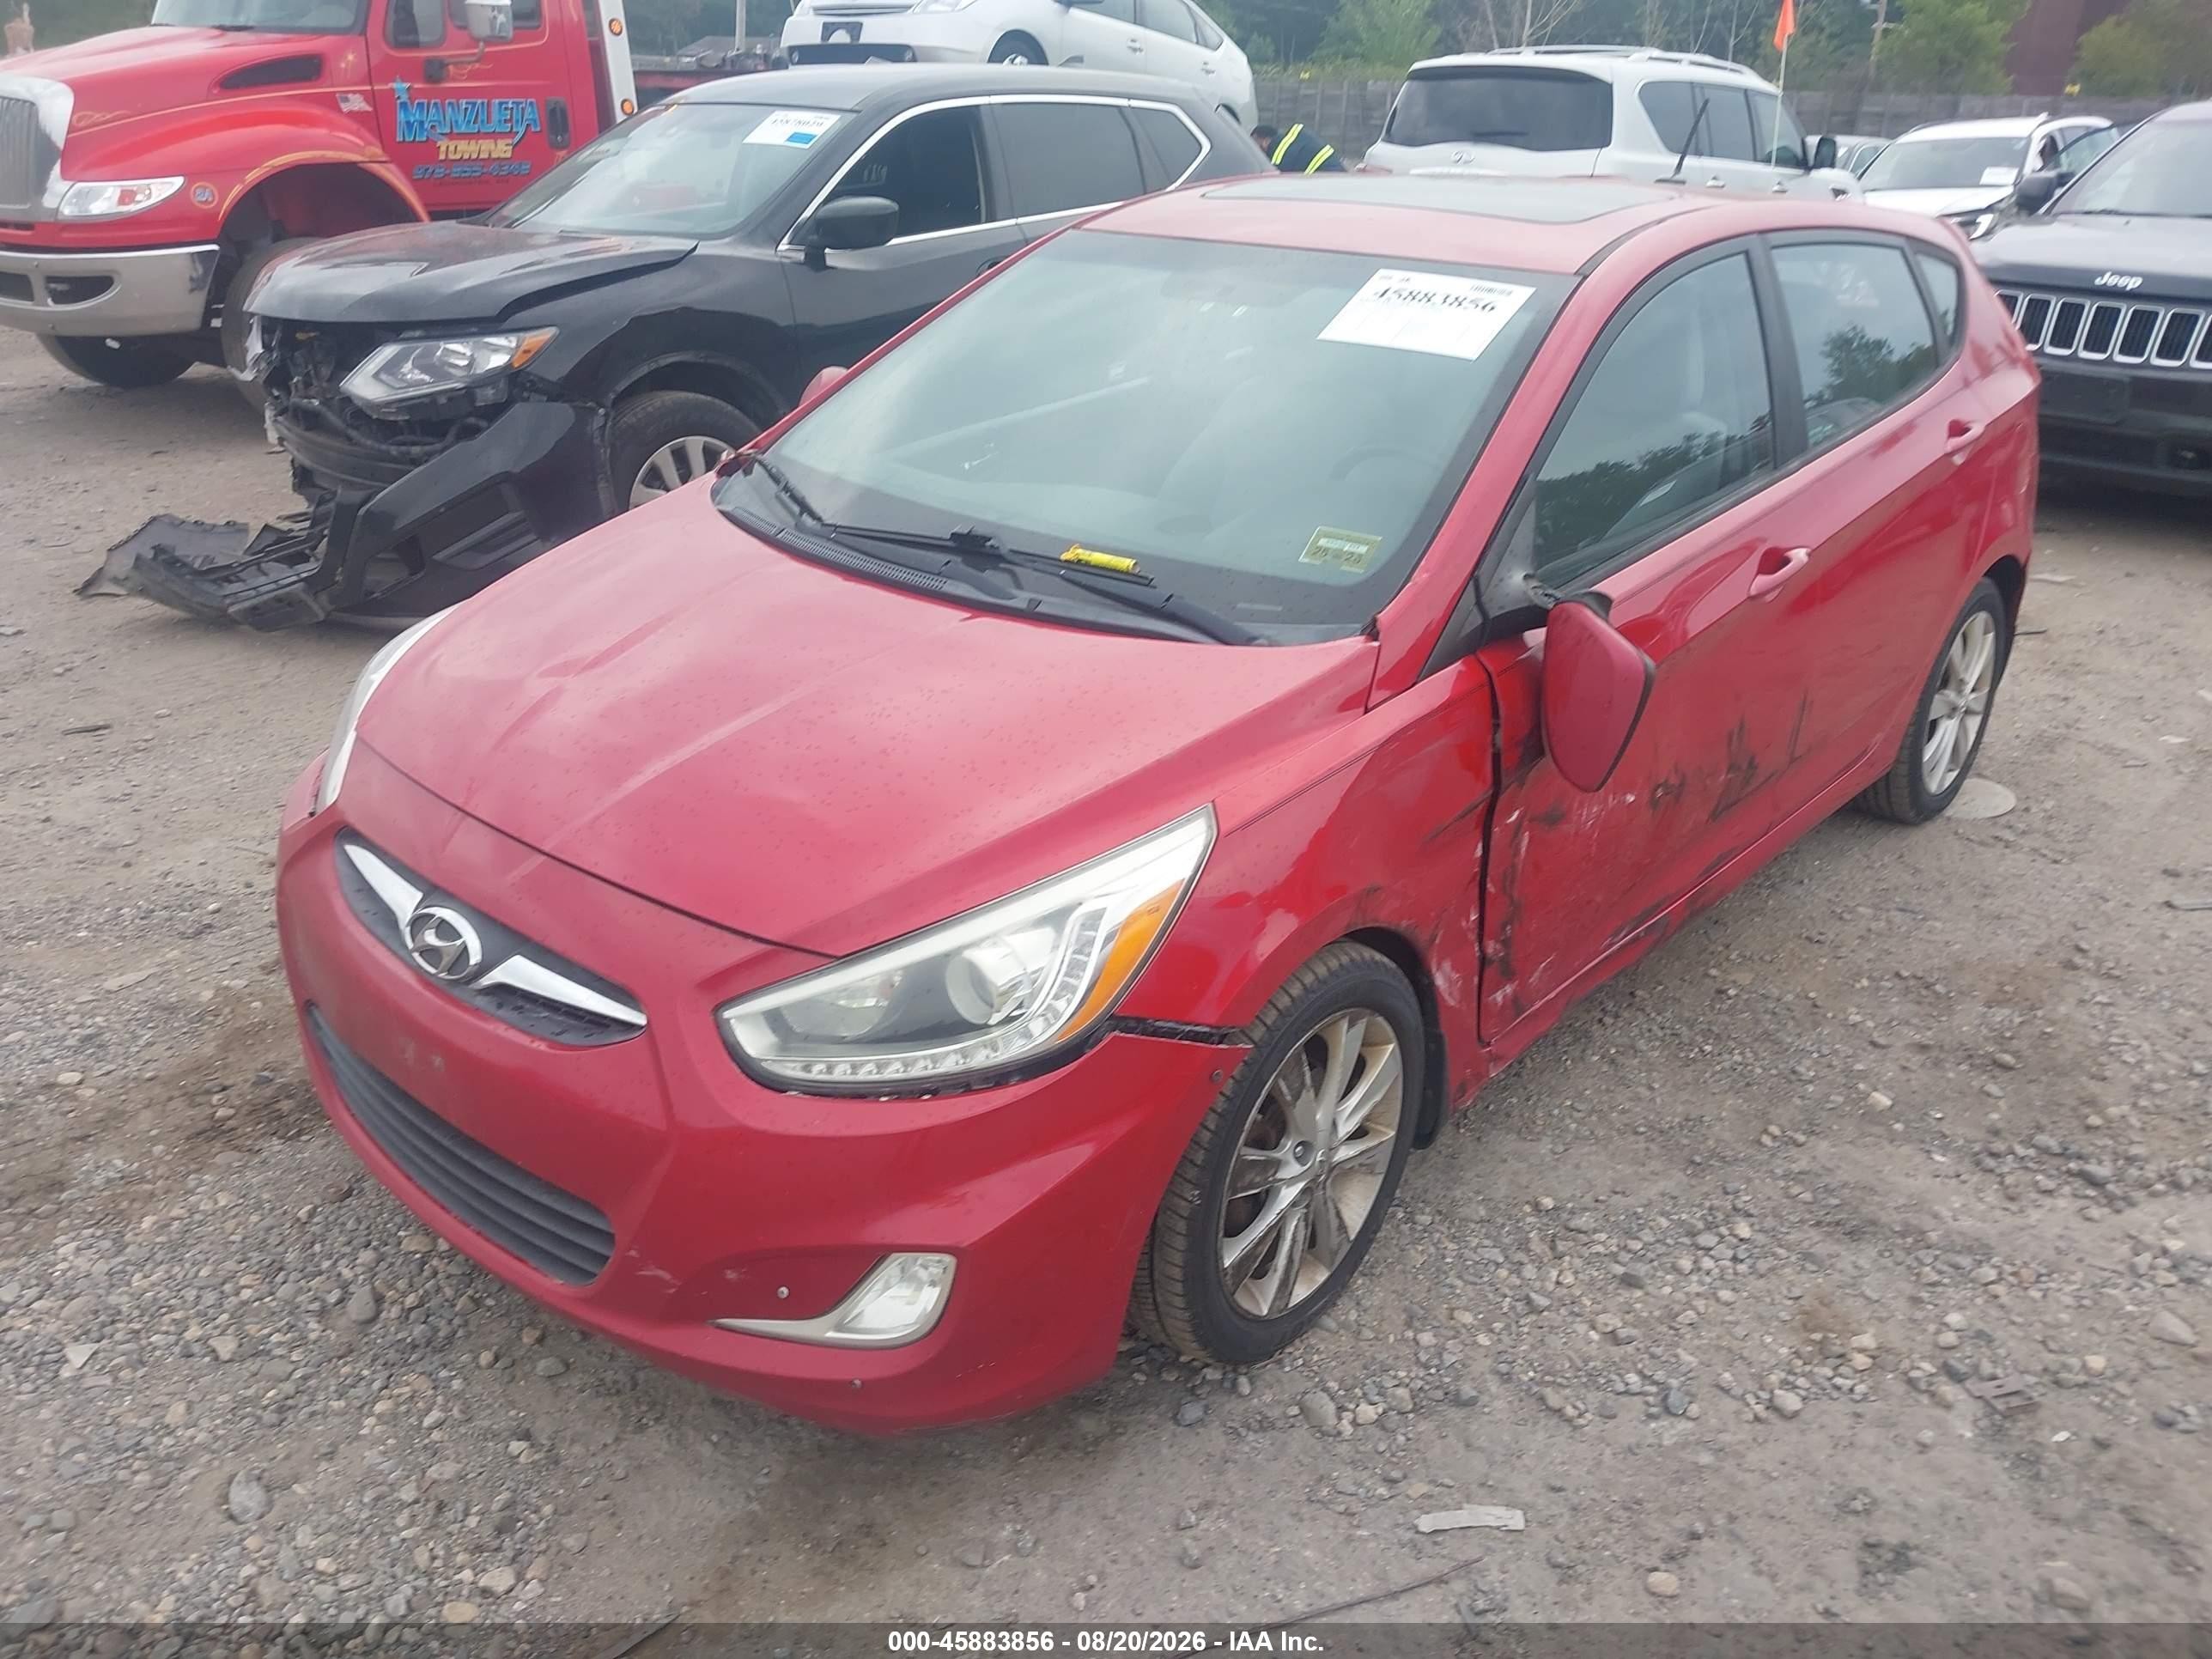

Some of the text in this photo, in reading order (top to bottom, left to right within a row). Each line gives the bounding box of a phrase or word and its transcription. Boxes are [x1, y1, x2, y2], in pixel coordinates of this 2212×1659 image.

[436, 138, 516, 161] TOWING
[2094, 270, 2143, 292] Jeep
[1374, 285, 1498, 313] 45883856
